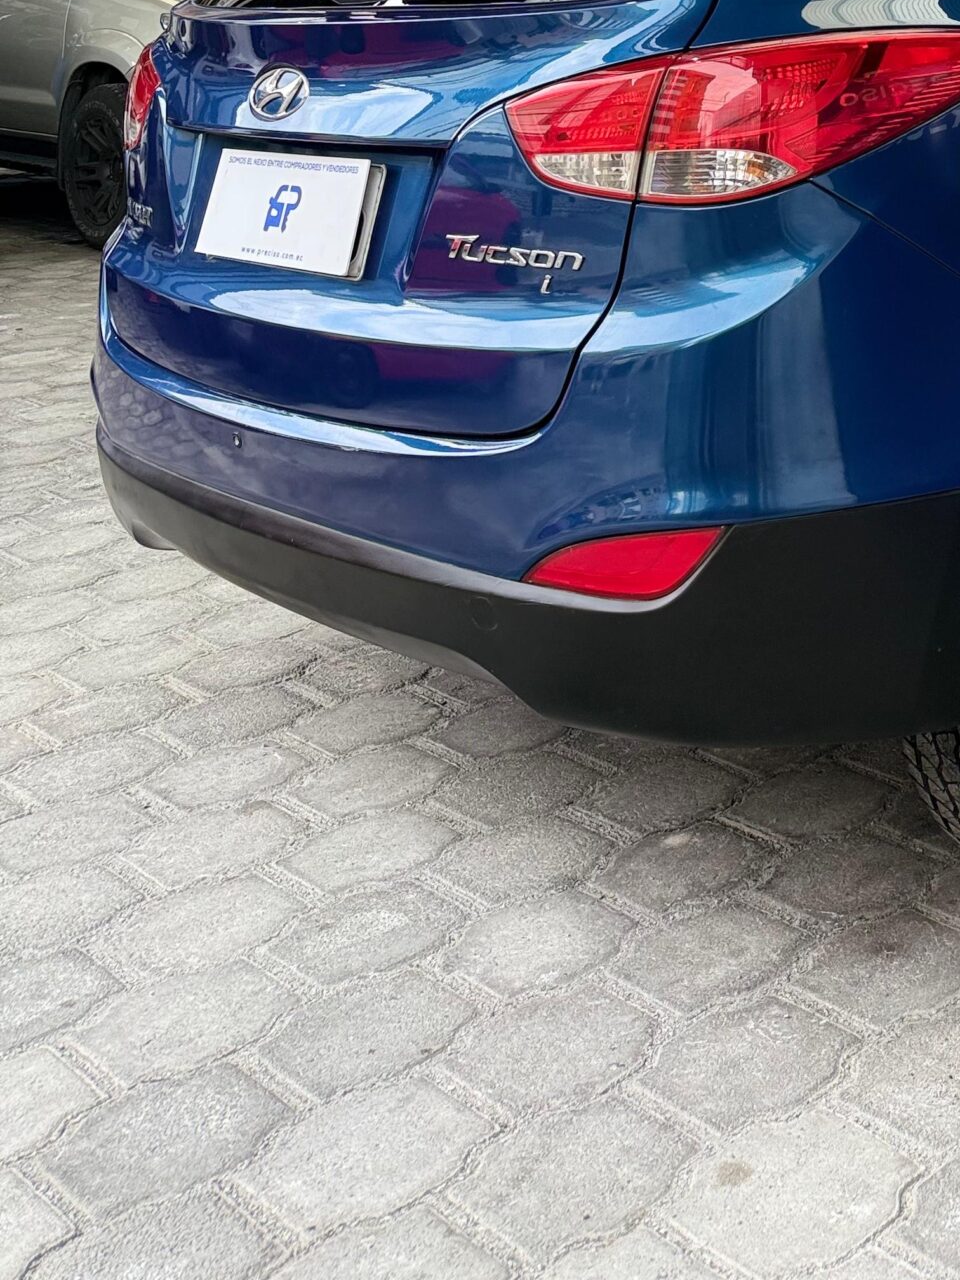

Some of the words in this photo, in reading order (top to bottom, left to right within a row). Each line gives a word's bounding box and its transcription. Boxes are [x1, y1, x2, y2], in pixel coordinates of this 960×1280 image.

[228, 156, 247, 165] SOMOS
[267, 159, 283, 168] ENTRE
[284, 160, 322, 171] COMPRADORES
[326, 164, 359, 174] VENDEDORES
[241, 247, 304, 262] www.preciso.com.ec
[445, 234, 584, 271] Tucson
